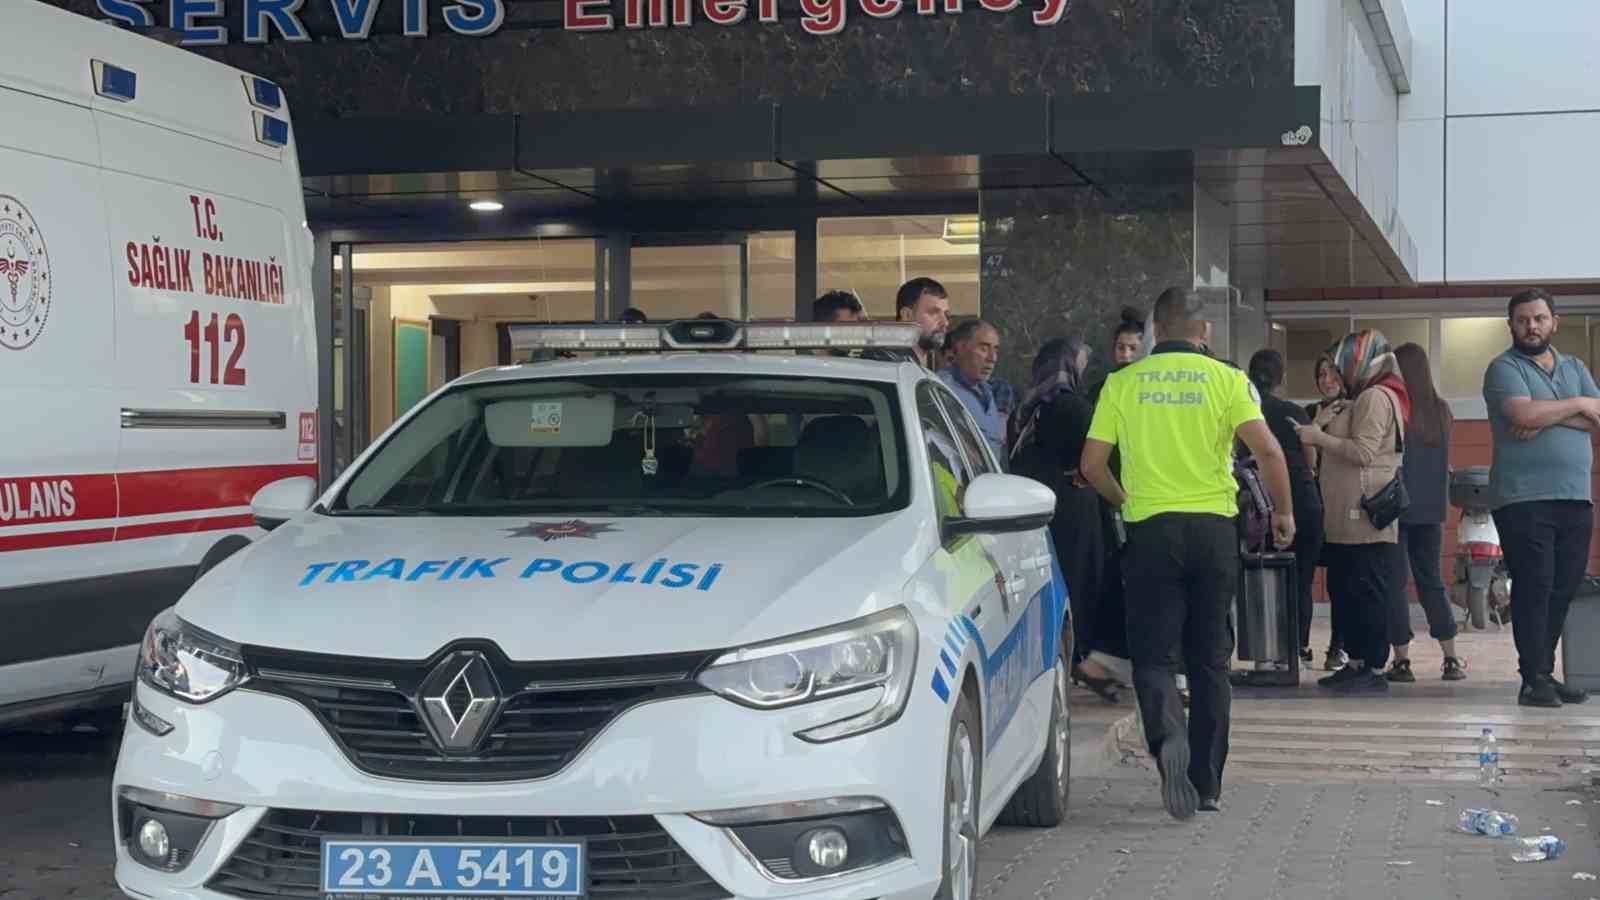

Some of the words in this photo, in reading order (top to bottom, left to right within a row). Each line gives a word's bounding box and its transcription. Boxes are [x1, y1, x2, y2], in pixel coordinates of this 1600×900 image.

[189, 195, 224, 242] T.C.
[126, 235, 195, 293] SAĞLIK
[202, 255, 285, 305] BAKANLIĞI
[184, 310, 246, 386] 112
[297, 556, 511, 587] TRAFİK
[519, 557, 724, 592] POLİSİ
[338, 847, 393, 886] 23
[405, 848, 442, 887] A
[455, 848, 569, 889] 5419
